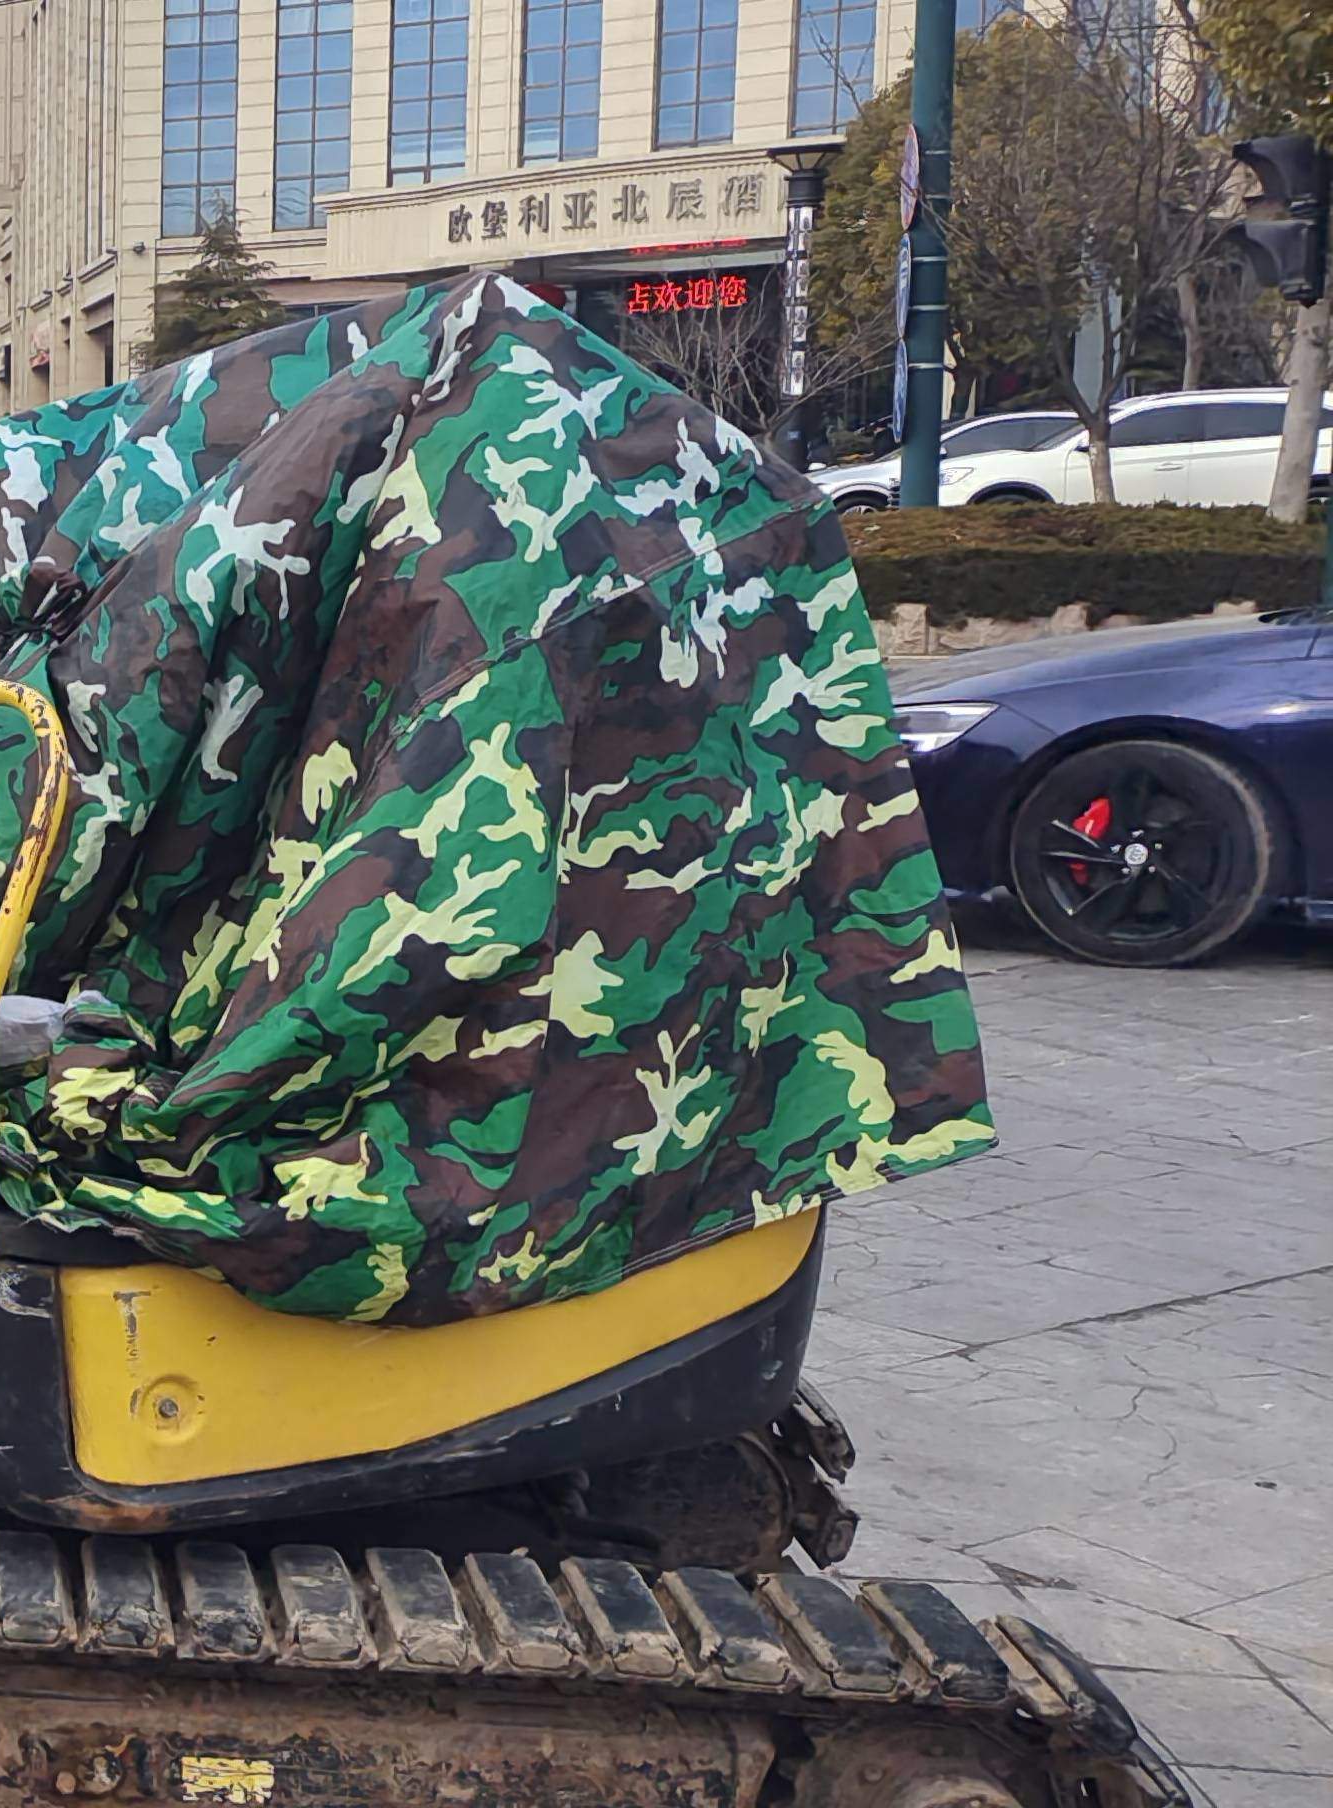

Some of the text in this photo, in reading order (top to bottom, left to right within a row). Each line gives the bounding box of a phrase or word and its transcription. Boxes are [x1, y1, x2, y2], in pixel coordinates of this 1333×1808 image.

[448, 172, 785, 243] 欧堡利亚北辰酒
